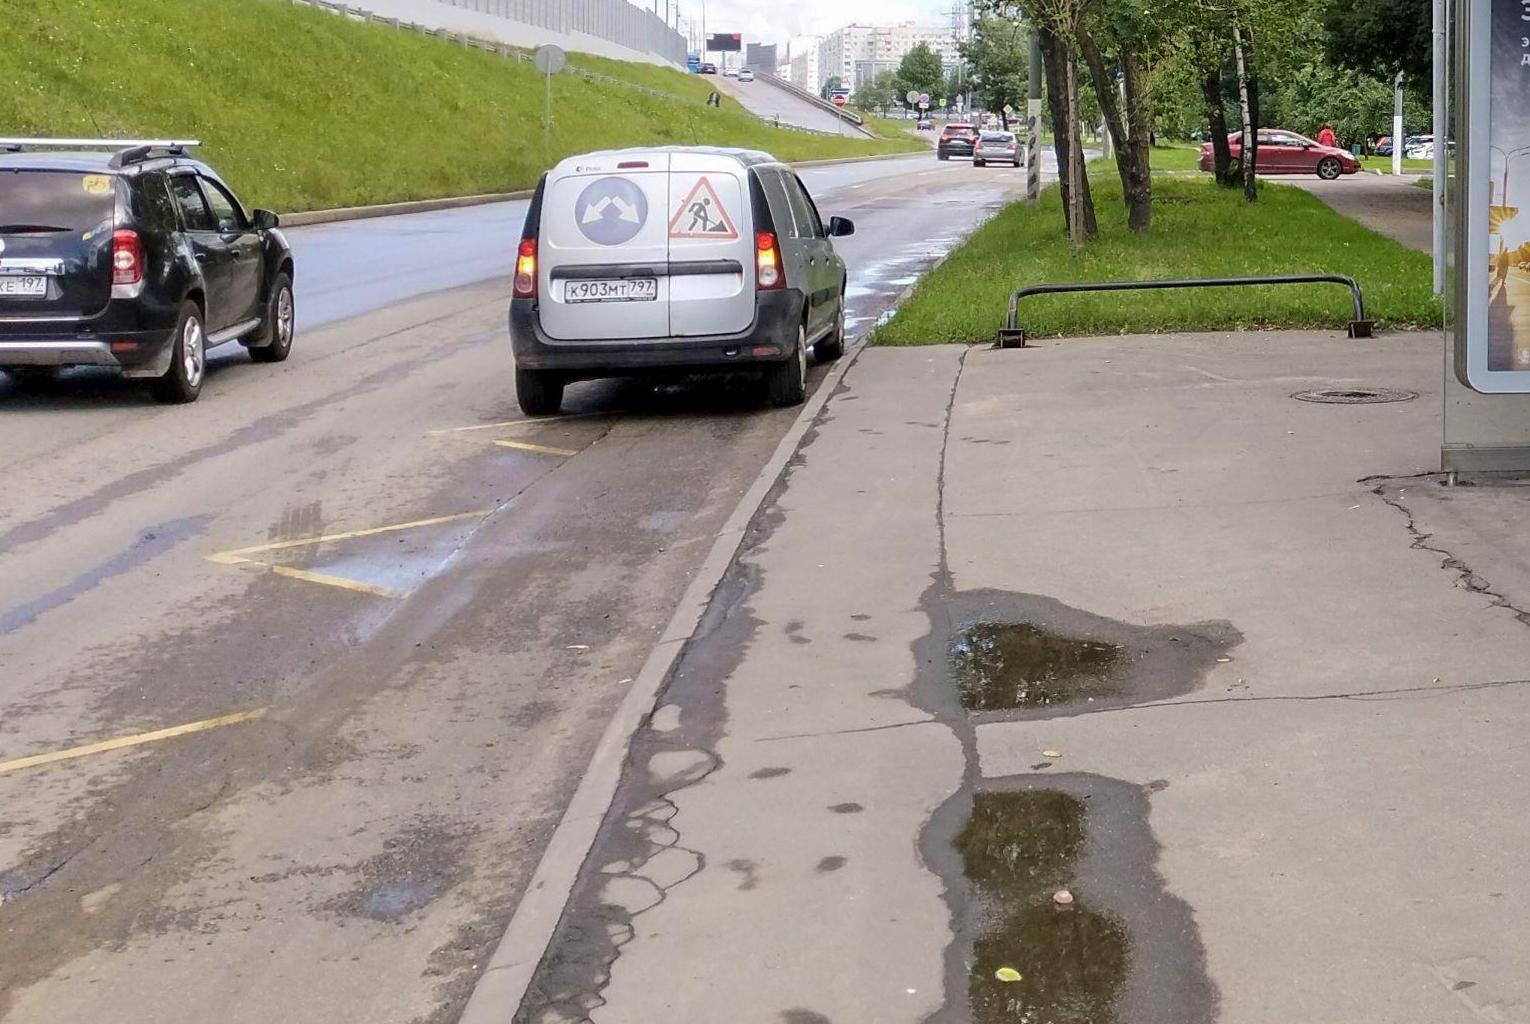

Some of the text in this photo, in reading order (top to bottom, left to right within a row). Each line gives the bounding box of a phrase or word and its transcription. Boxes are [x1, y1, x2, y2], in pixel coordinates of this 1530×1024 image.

[22, 277, 42, 288] 197
[570, 281, 652, 297] К903МТ 797
